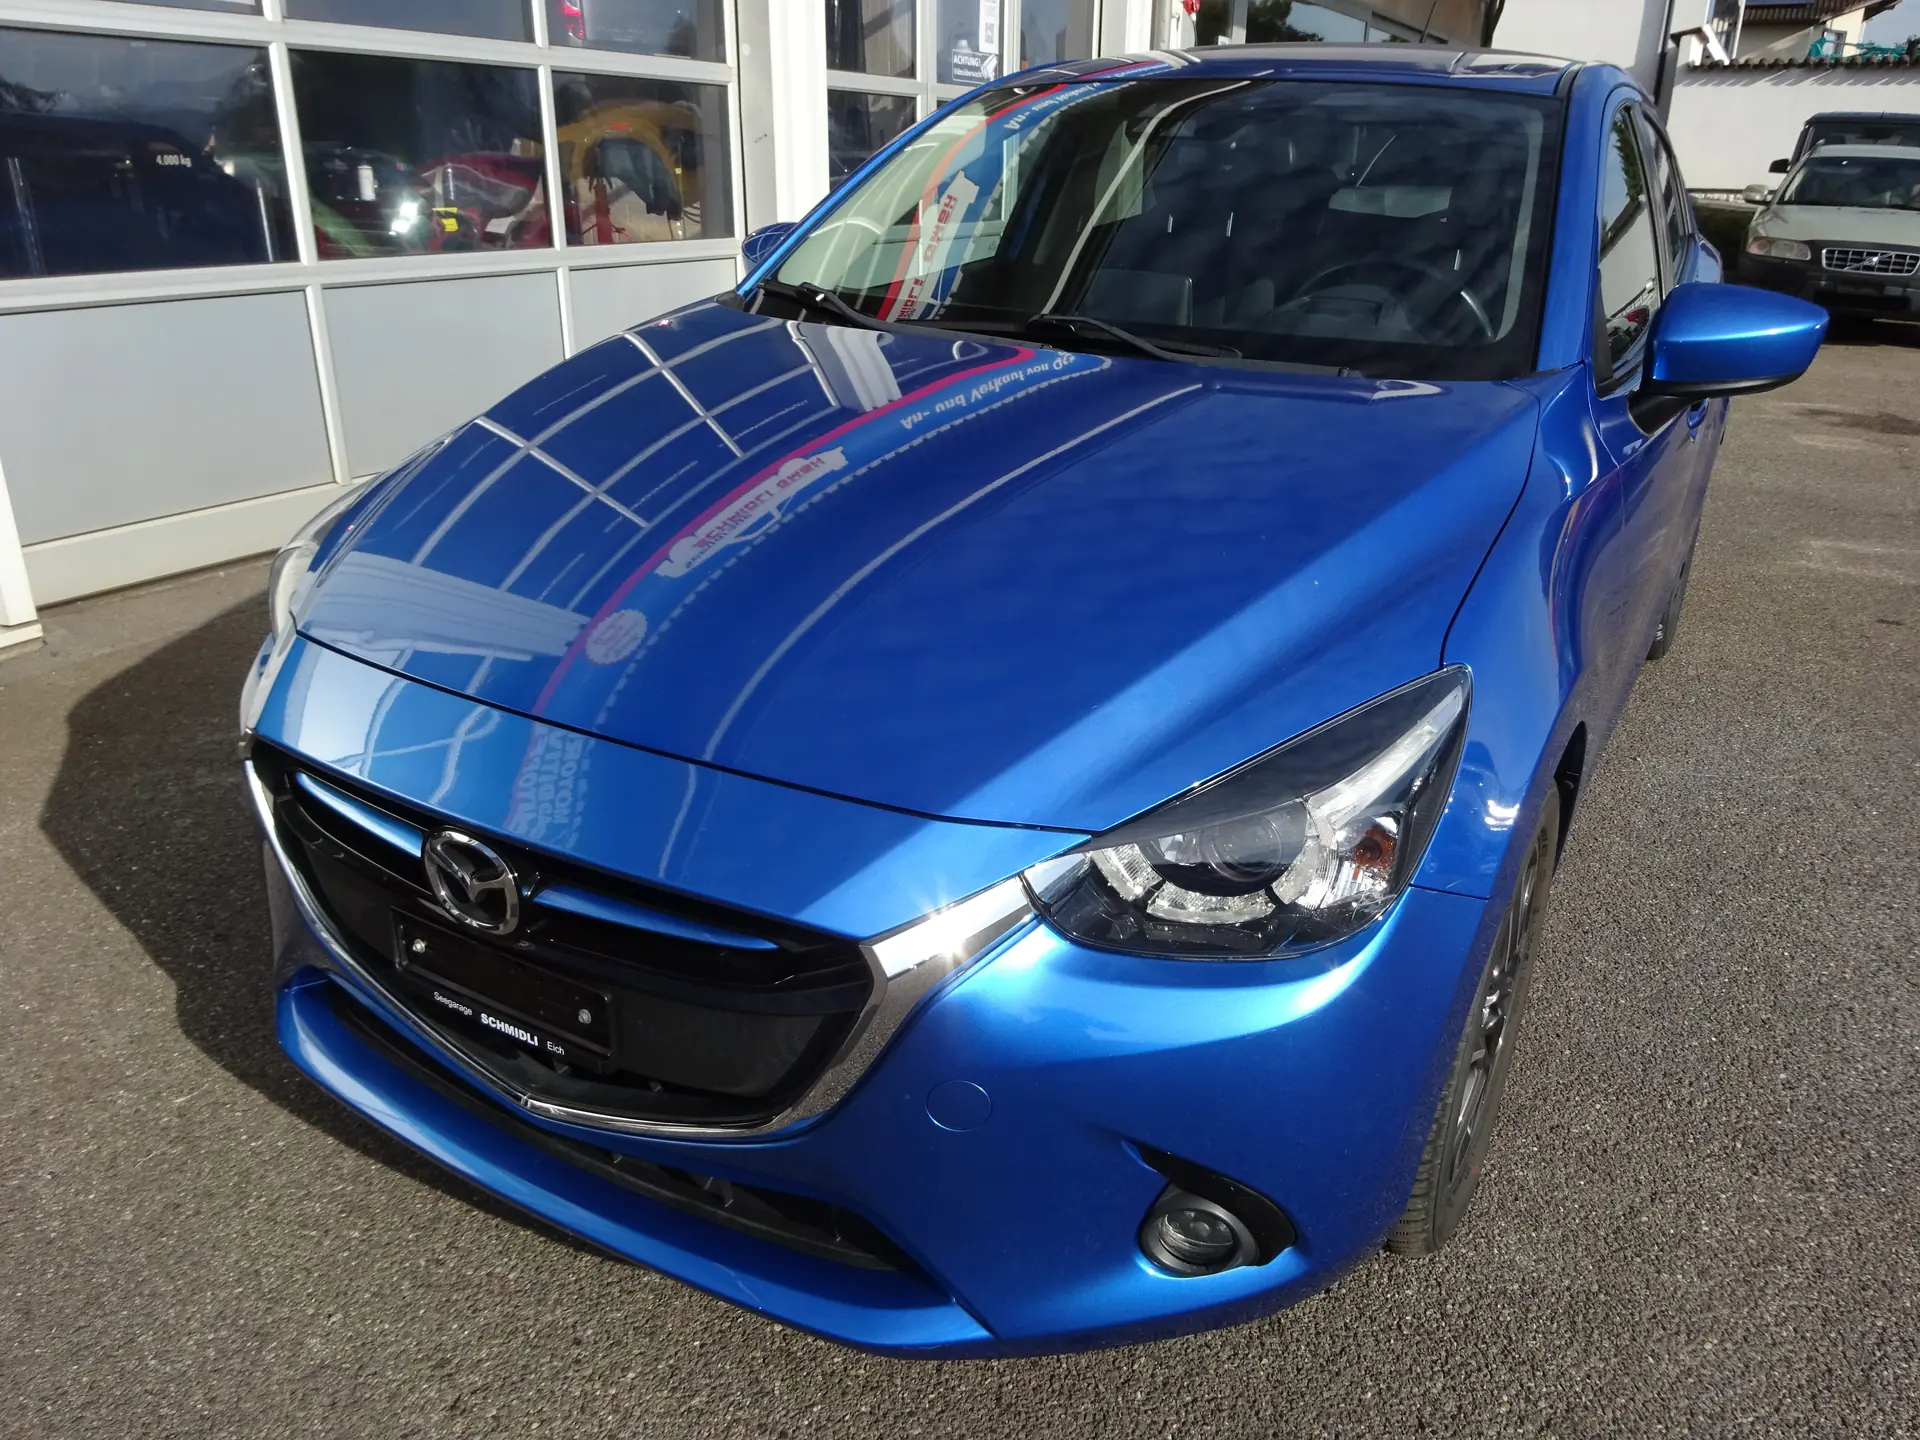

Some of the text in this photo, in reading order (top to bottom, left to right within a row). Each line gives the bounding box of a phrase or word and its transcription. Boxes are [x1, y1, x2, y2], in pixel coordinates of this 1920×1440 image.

[180, 154, 192, 168] kg
[434, 991, 565, 1056] Seegarage SCHMIDLI Eich
